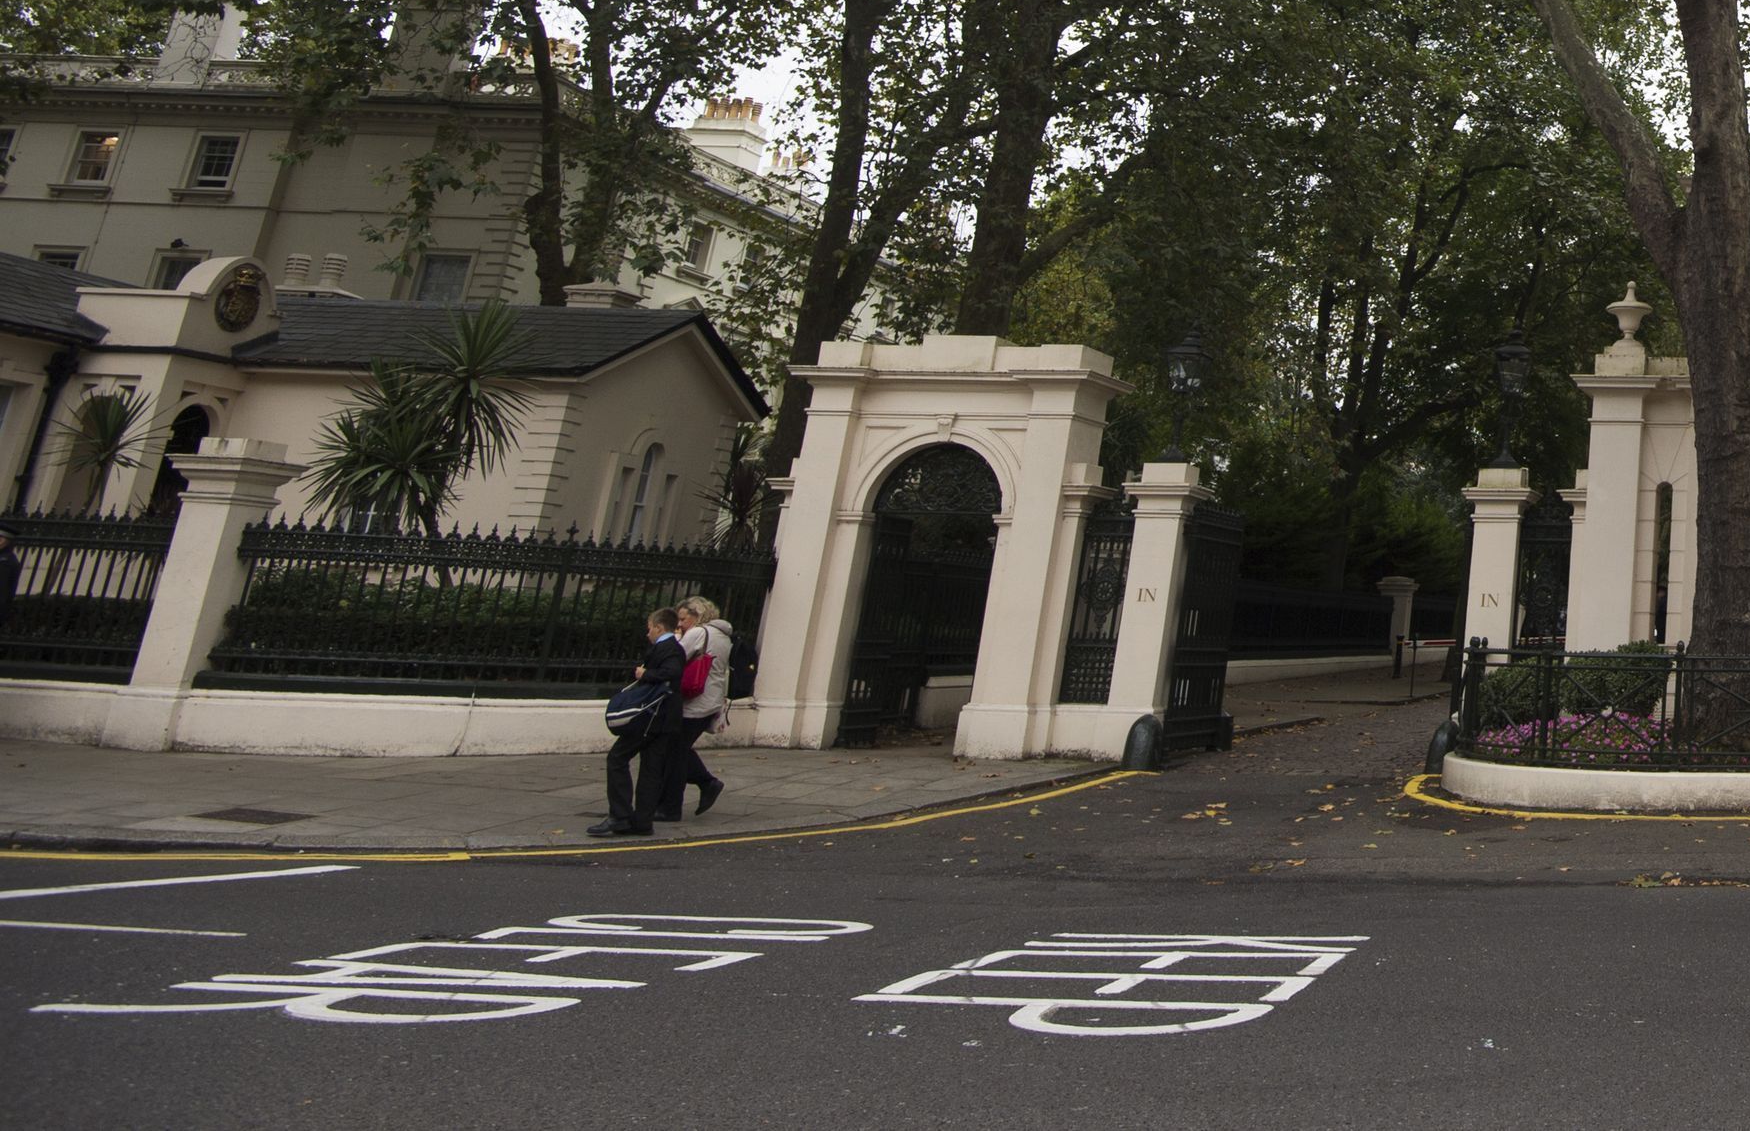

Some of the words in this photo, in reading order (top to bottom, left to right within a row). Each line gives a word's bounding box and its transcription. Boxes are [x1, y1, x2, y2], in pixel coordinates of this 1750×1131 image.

[1136, 588, 1158, 602] IN
[1480, 593, 1500, 607] IN
[28, 914, 874, 1023] CLEAR
[851, 933, 1371, 1036] KEEP
